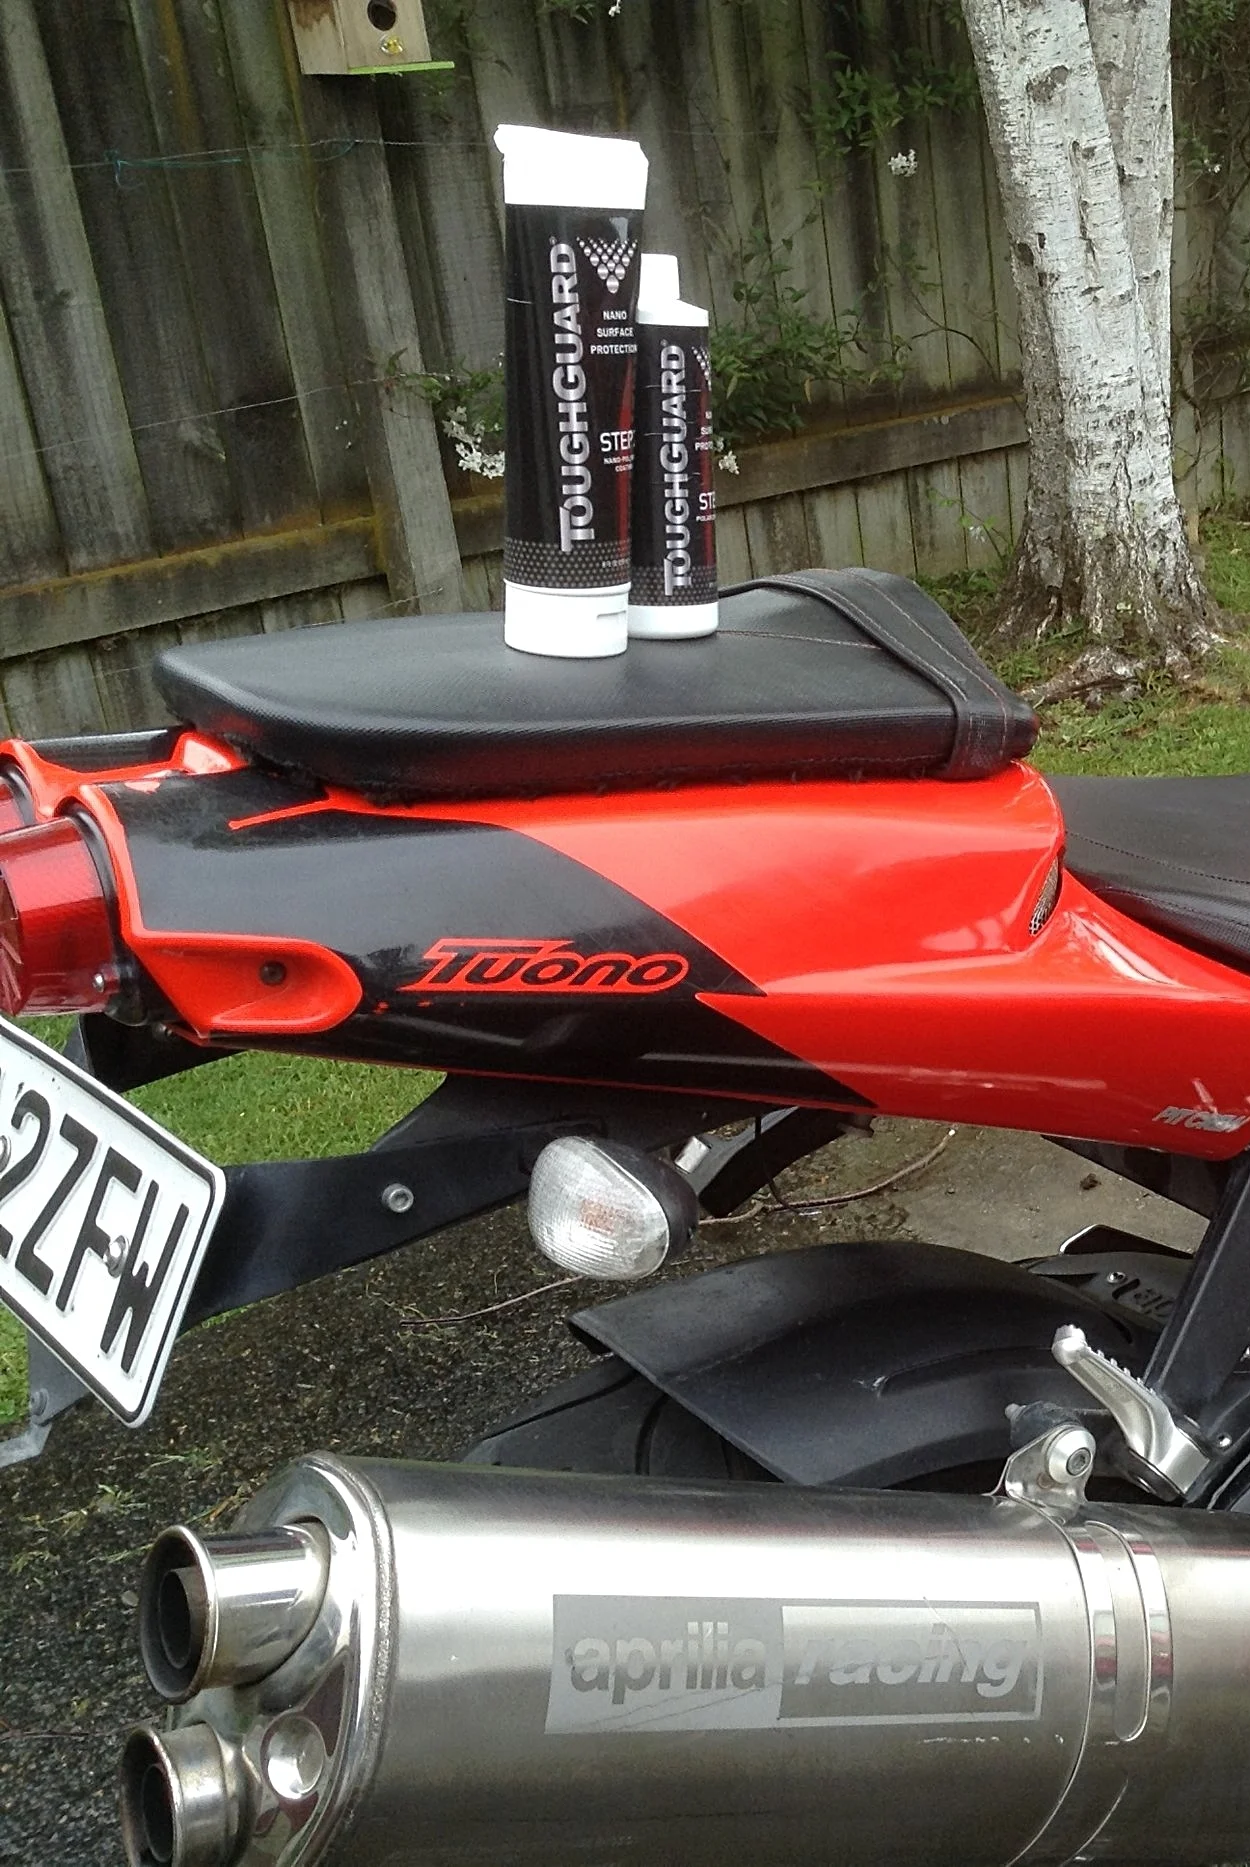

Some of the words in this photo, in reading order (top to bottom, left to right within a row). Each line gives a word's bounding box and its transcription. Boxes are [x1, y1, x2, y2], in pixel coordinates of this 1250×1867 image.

[596, 327, 635, 338] SURFACE
[602, 310, 628, 321] NANO
[549, 243, 596, 553] TOUGHGUARD
[660, 345, 692, 597] TOUGHGUARD
[570, 1621, 766, 1705] aprilia
[793, 1621, 1029, 1699] racing
